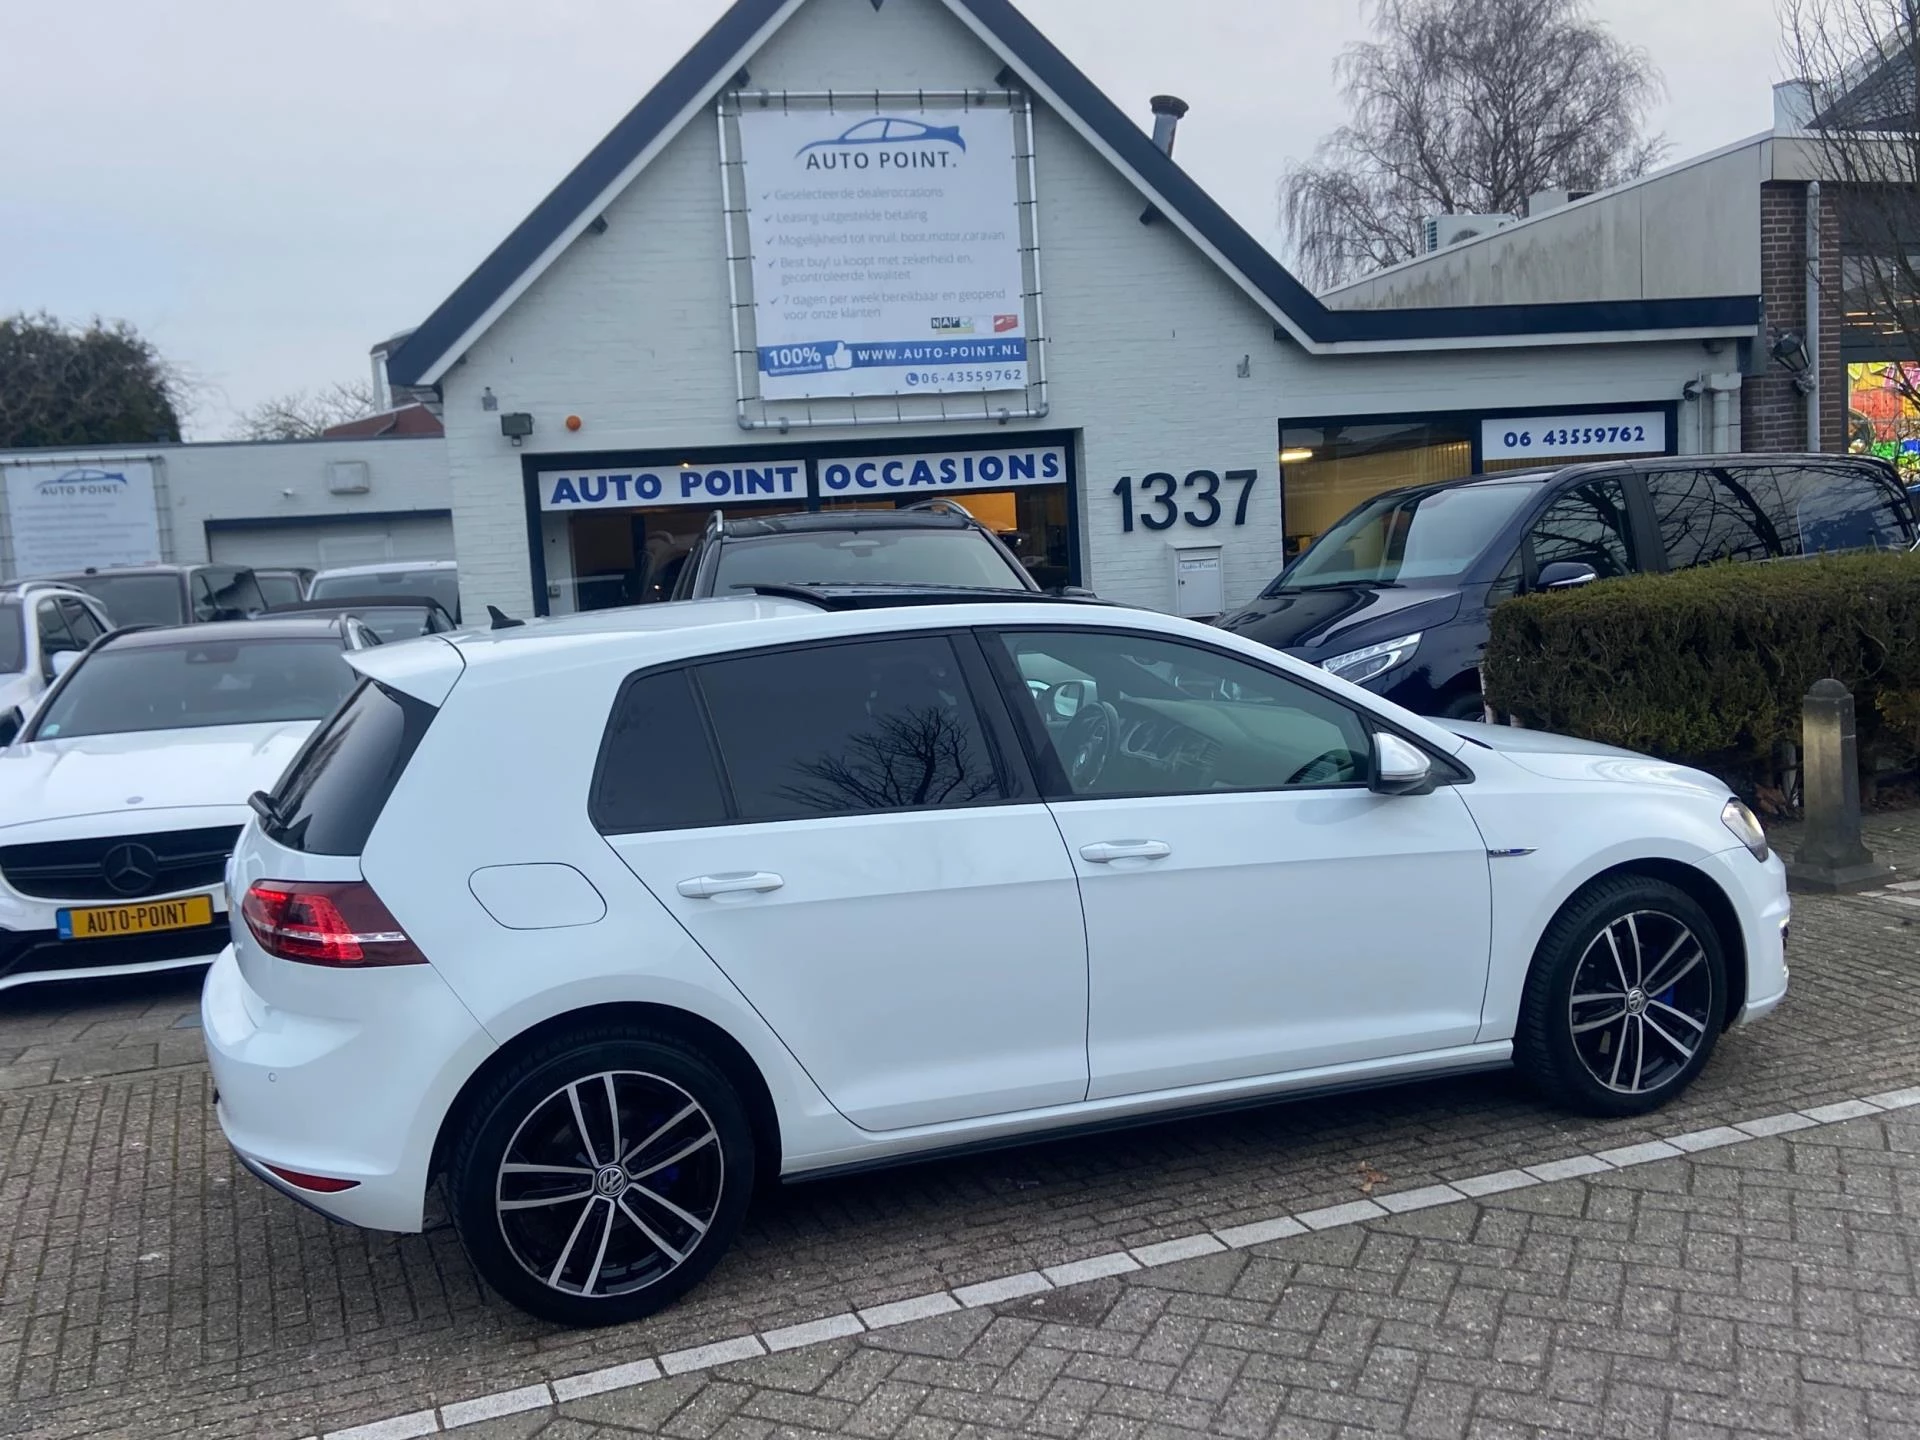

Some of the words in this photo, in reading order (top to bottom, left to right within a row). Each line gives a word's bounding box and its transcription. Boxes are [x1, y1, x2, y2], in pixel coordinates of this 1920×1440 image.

[806, 152, 870, 170] AUTO
[774, 188, 854, 200] Geselecteerde
[857, 186, 944, 199] dealeroccasions
[777, 212, 819, 225] Leasing
[821, 210, 882, 224] uitgestelde
[884, 208, 928, 223] betaling
[778, 233, 847, 248] Mogelijkheid
[850, 233, 865, 244] tot
[780, 257, 804, 268] Best
[843, 255, 875, 268] koopt
[878, 255, 899, 266] met
[902, 253, 954, 265] zekerheid
[781, 271, 865, 286] gecontroleerde
[867, 269, 911, 281] kwaliteit
[783, 294, 790, 305] 7
[792, 294, 827, 308] dagen
[829, 294, 847, 306] per
[850, 291, 880, 303] week
[882, 290, 939, 303] bereikbaar
[942, 291, 956, 301] en
[958, 288, 1006, 303] geopend
[783, 310, 808, 320] voor
[811, 308, 838, 319] onze
[840, 306, 881, 318] klanten
[931, 316, 960, 329] NAP
[769, 346, 821, 367] 100%
[857, 344, 1021, 361] WWW.AUTO-POINT.NL
[921, 369, 1022, 384] 06-43559762
[1503, 431, 1532, 448] 06
[1542, 425, 1645, 446] 43559762
[551, 473, 662, 504] AUTO
[680, 466, 798, 498] POINT
[825, 452, 1059, 490] OCCASIONS
[41, 485, 76, 496] AUTO
[1112, 469, 1258, 533] 1337
[87, 902, 188, 933] AUTO-POINT
